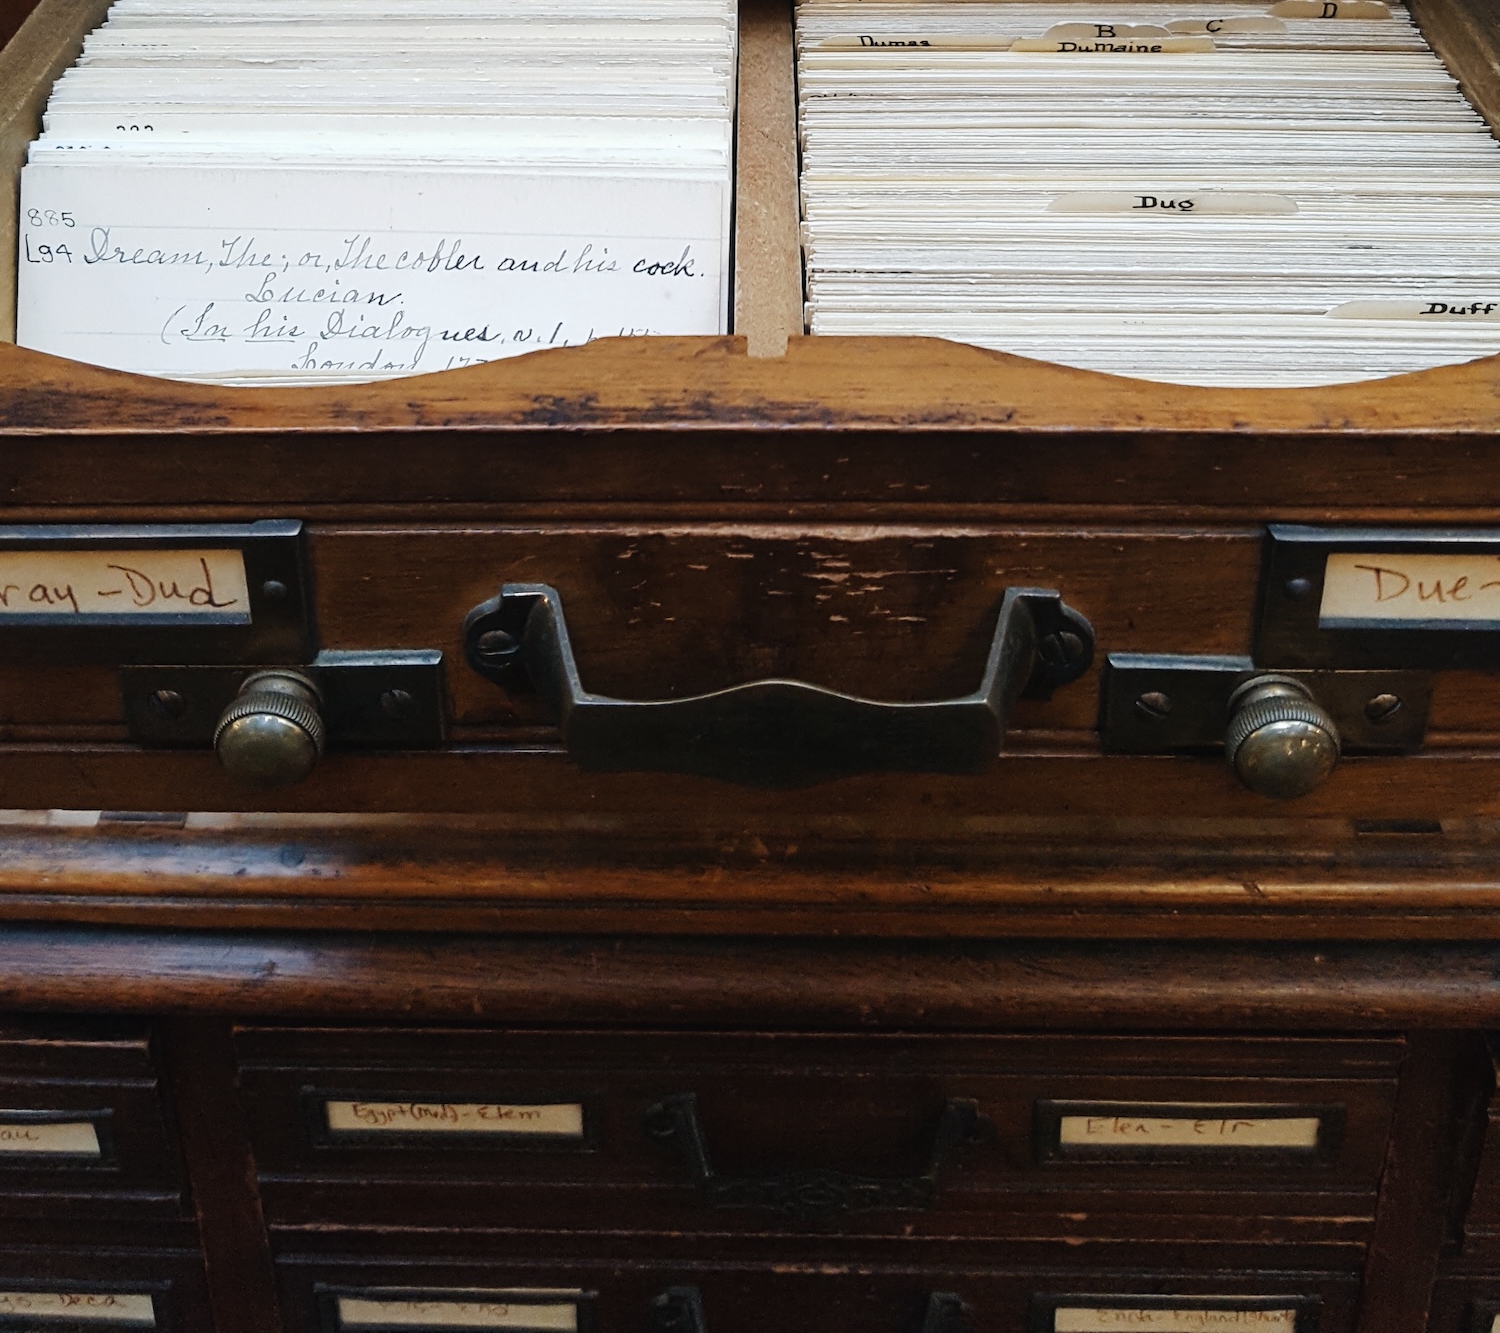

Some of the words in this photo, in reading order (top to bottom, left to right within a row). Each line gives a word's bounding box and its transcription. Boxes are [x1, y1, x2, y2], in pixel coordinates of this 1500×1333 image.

[1318, 2, 1338, 18] D
[1094, 24, 1116, 38] B
[1206, 19, 1223, 33] C
[27, 208, 76, 228] 885
[84, 227, 213, 274] Dream,
[497, 249, 568, 272] and
[572, 243, 622, 274] his
[245, 272, 404, 306] Lucian.
